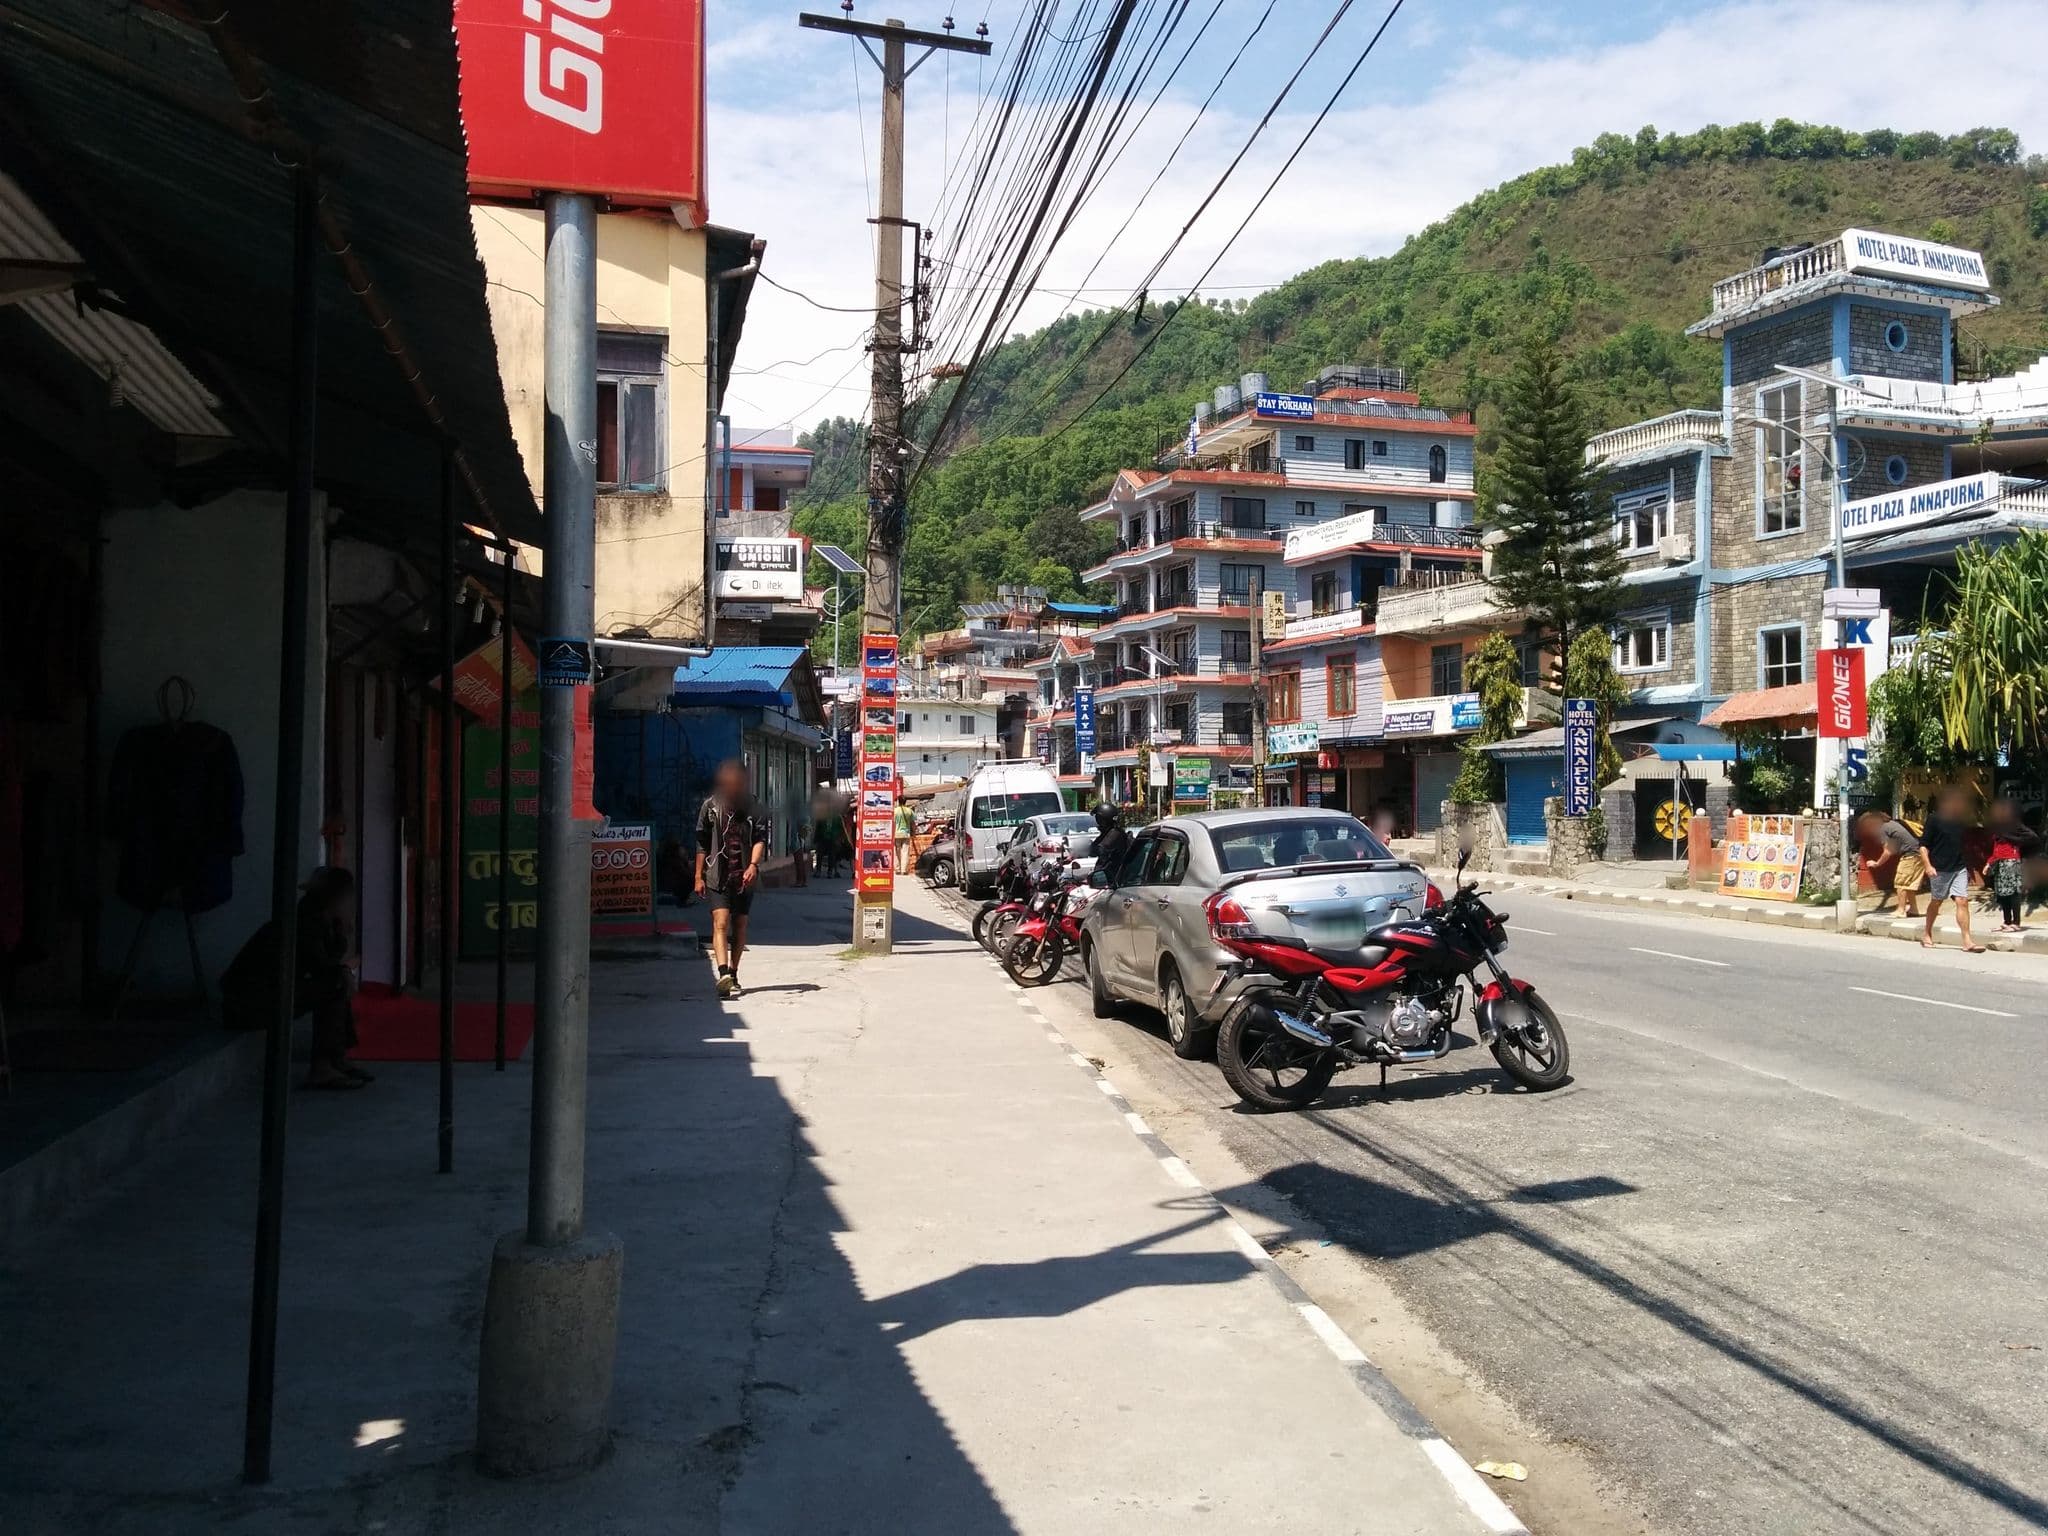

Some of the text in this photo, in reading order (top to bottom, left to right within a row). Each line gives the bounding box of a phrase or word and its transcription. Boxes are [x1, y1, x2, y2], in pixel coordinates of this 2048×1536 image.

[1857, 236, 1983, 277] HOTEL PLAZA ANNAPURNA
[1257, 398, 1313, 411] STAY POKHARA
[1842, 480, 1985, 529] OTEL PLAZA ANNAPURNA
[719, 544, 781, 554] WESTERN
[738, 553, 782, 562] UNION
[1081, 695, 1090, 730] STAY
[1391, 713, 1412, 724] Nepal
[1413, 711, 1432, 721] Craft
[1568, 711, 1594, 719] HOTEL
[1574, 727, 1589, 815] ANNAPURNA
[617, 827, 648, 840] Agent
[592, 850, 648, 868] TNT
[597, 872, 649, 885] express
